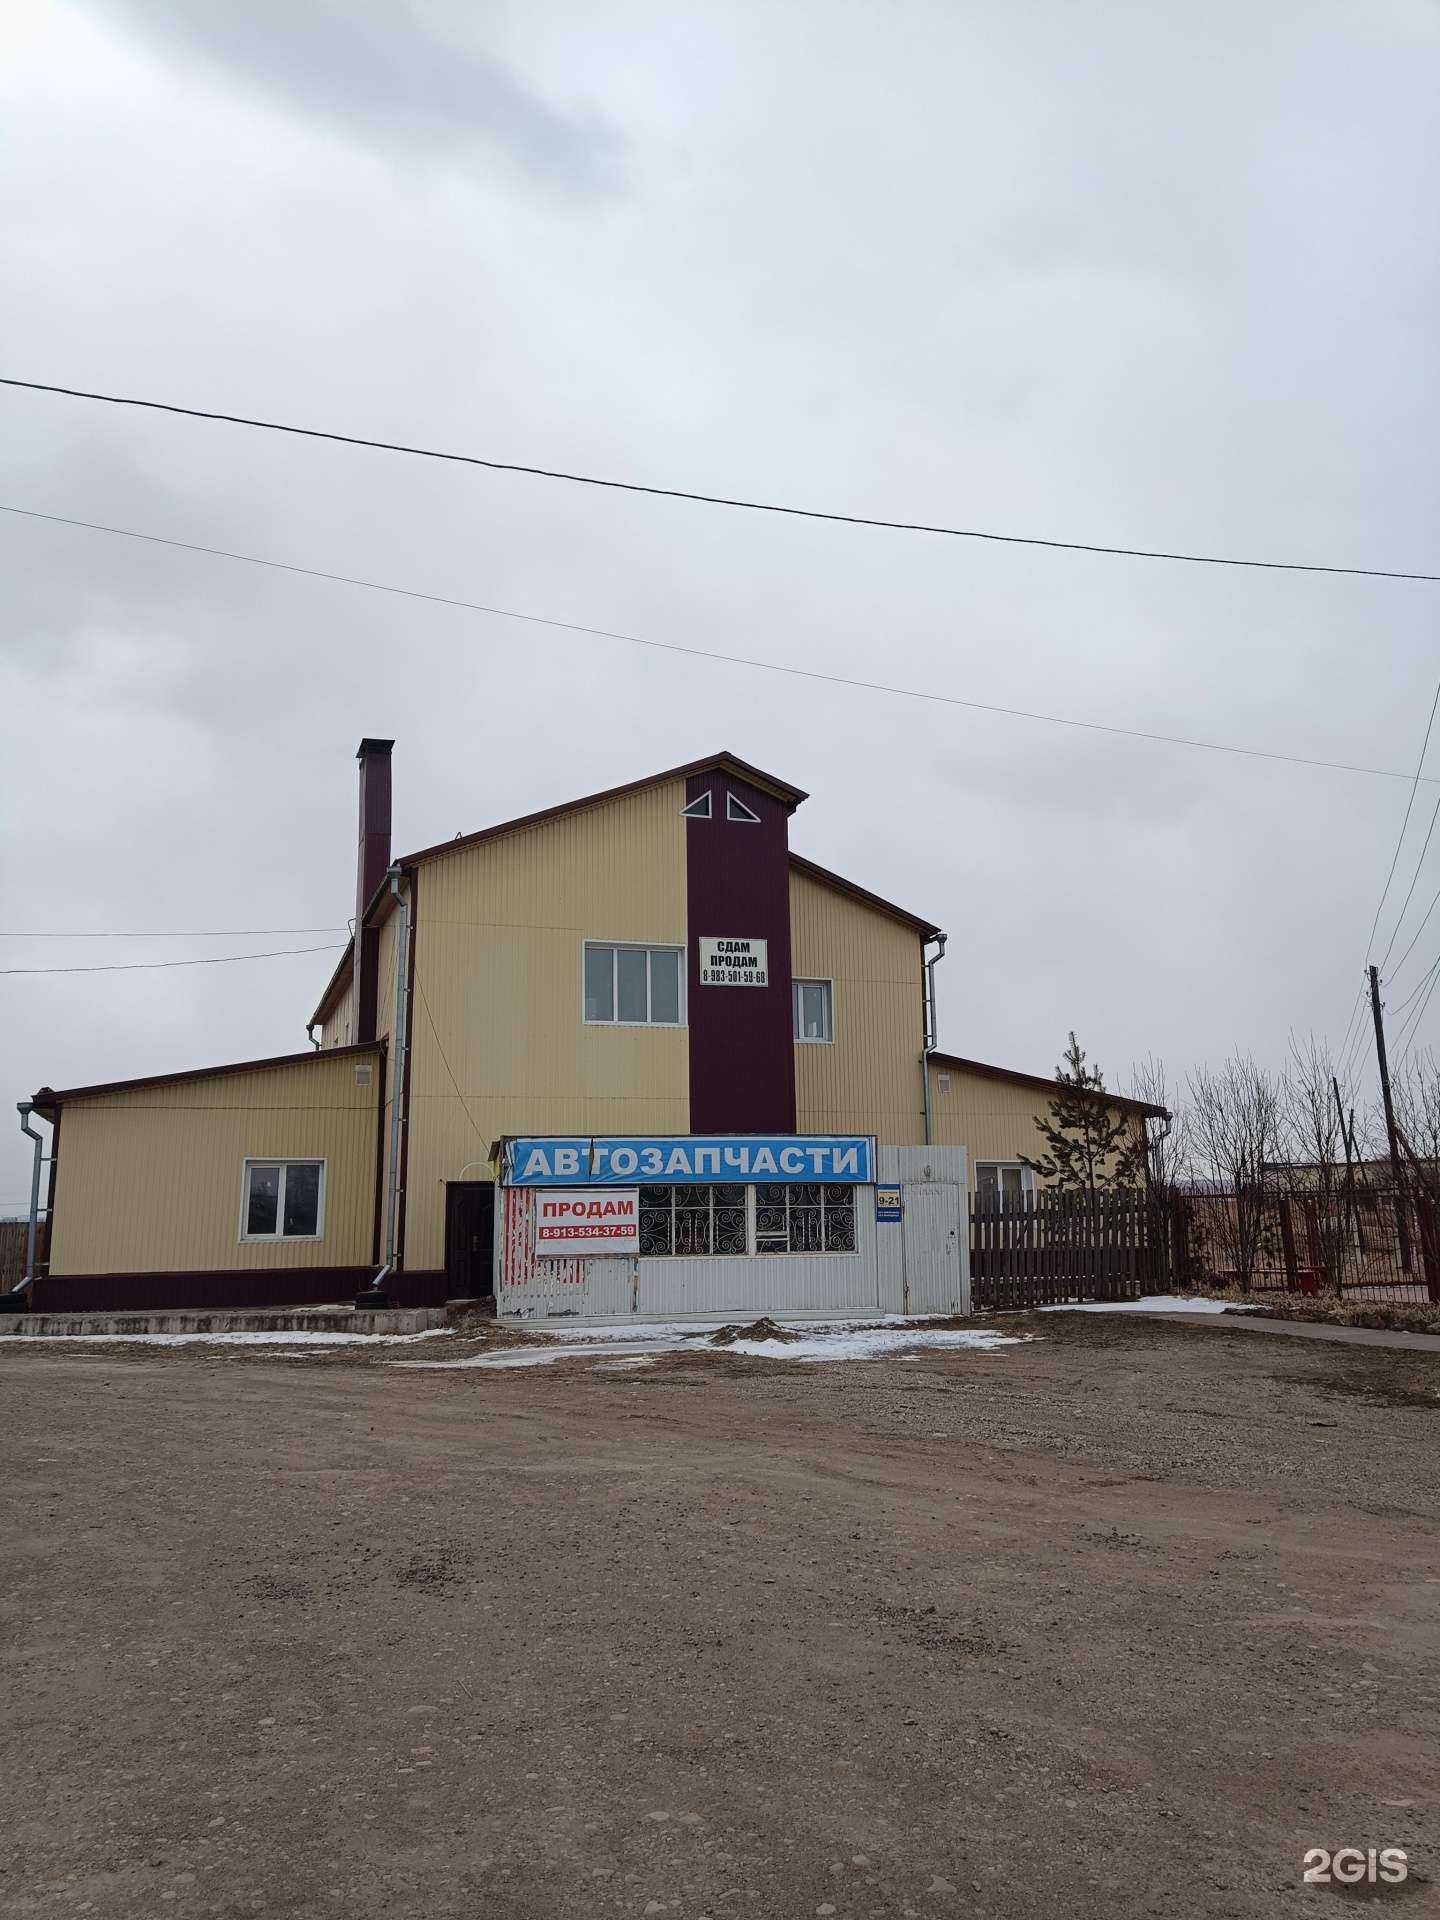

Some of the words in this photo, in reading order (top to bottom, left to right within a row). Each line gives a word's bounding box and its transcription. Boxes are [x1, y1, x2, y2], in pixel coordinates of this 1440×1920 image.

[717, 941, 750, 953] СДАМ
[710, 955, 758, 968] ПРОДАМ
[522, 1147, 858, 1176] АВТОЗАПЧАСТИ
[543, 1200, 634, 1219] ПРОДАМ
[542, 1226, 634, 1238] 8-913-534-37-59
